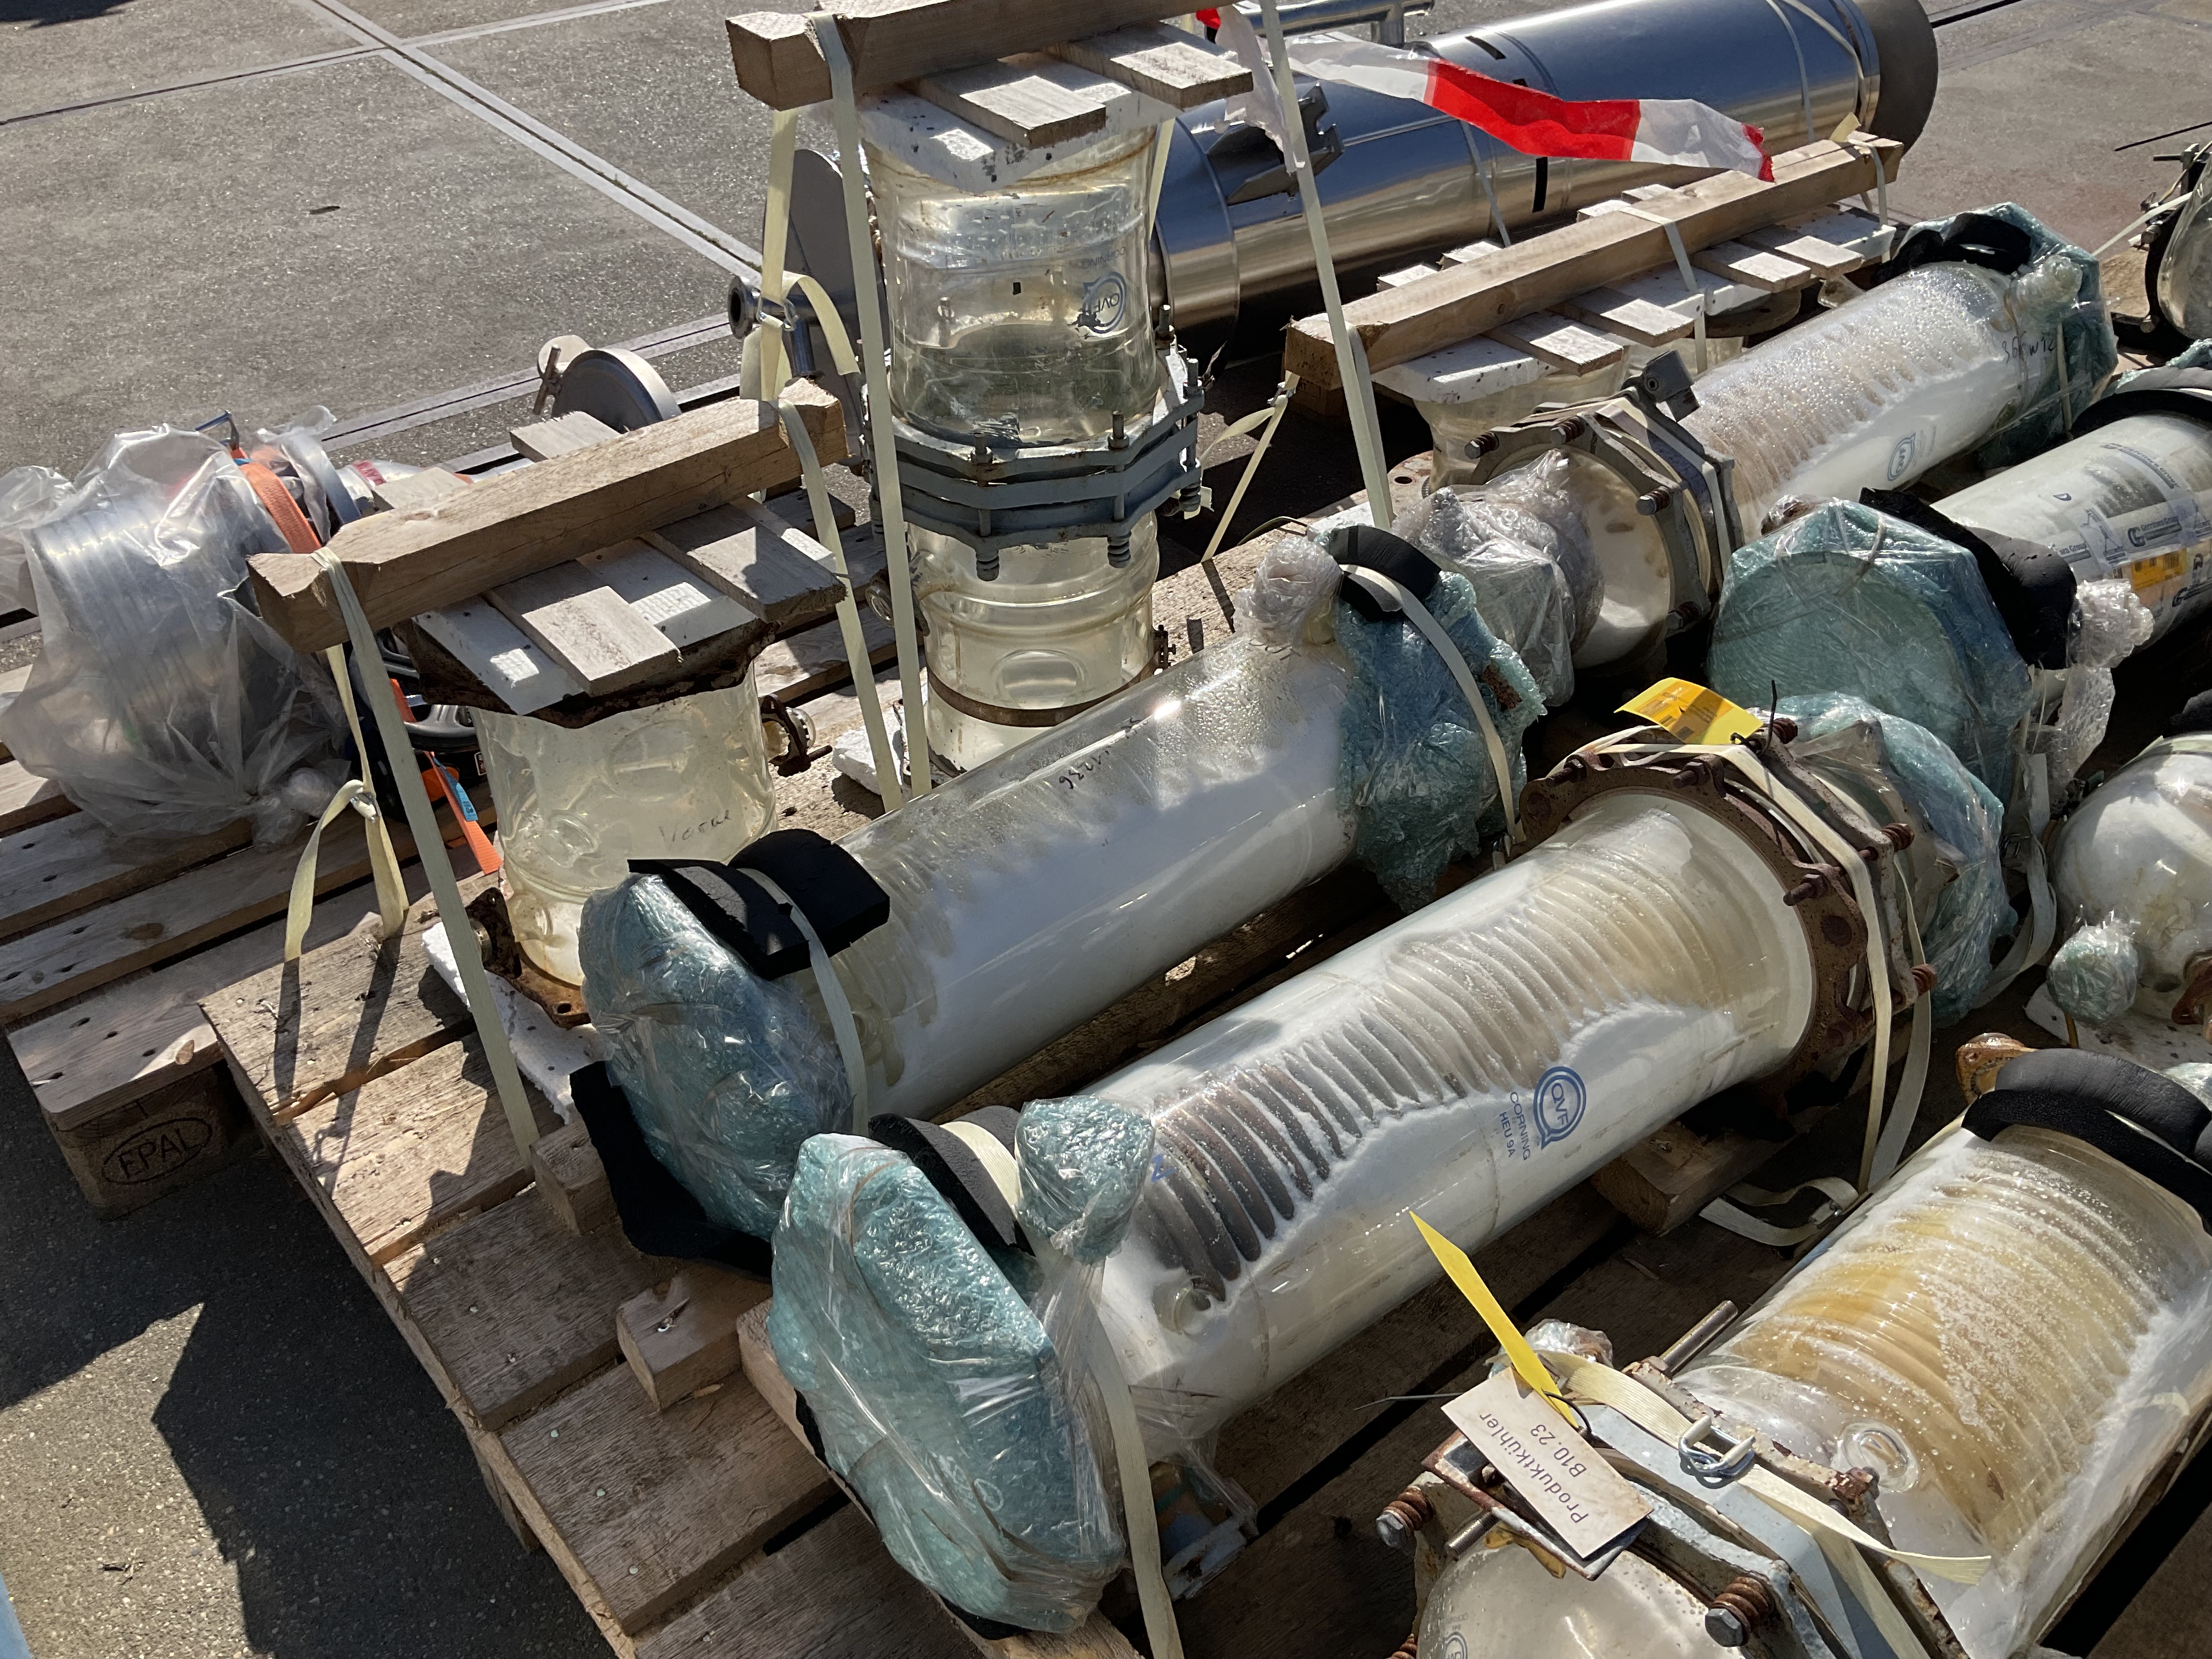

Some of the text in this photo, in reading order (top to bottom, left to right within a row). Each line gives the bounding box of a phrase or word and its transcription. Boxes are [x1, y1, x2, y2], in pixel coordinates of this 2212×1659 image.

[1895, 448, 1906, 474] QVF
[2069, 543, 2088, 552] Group
[1510, 1091, 1531, 1161] CORNING
[1551, 1082, 1568, 1125] QVF
[117, 1127, 204, 1179] EPAL
[1499, 1111, 1516, 1158] HEU 9A
[1480, 1413, 1589, 1523] Produktkühler
